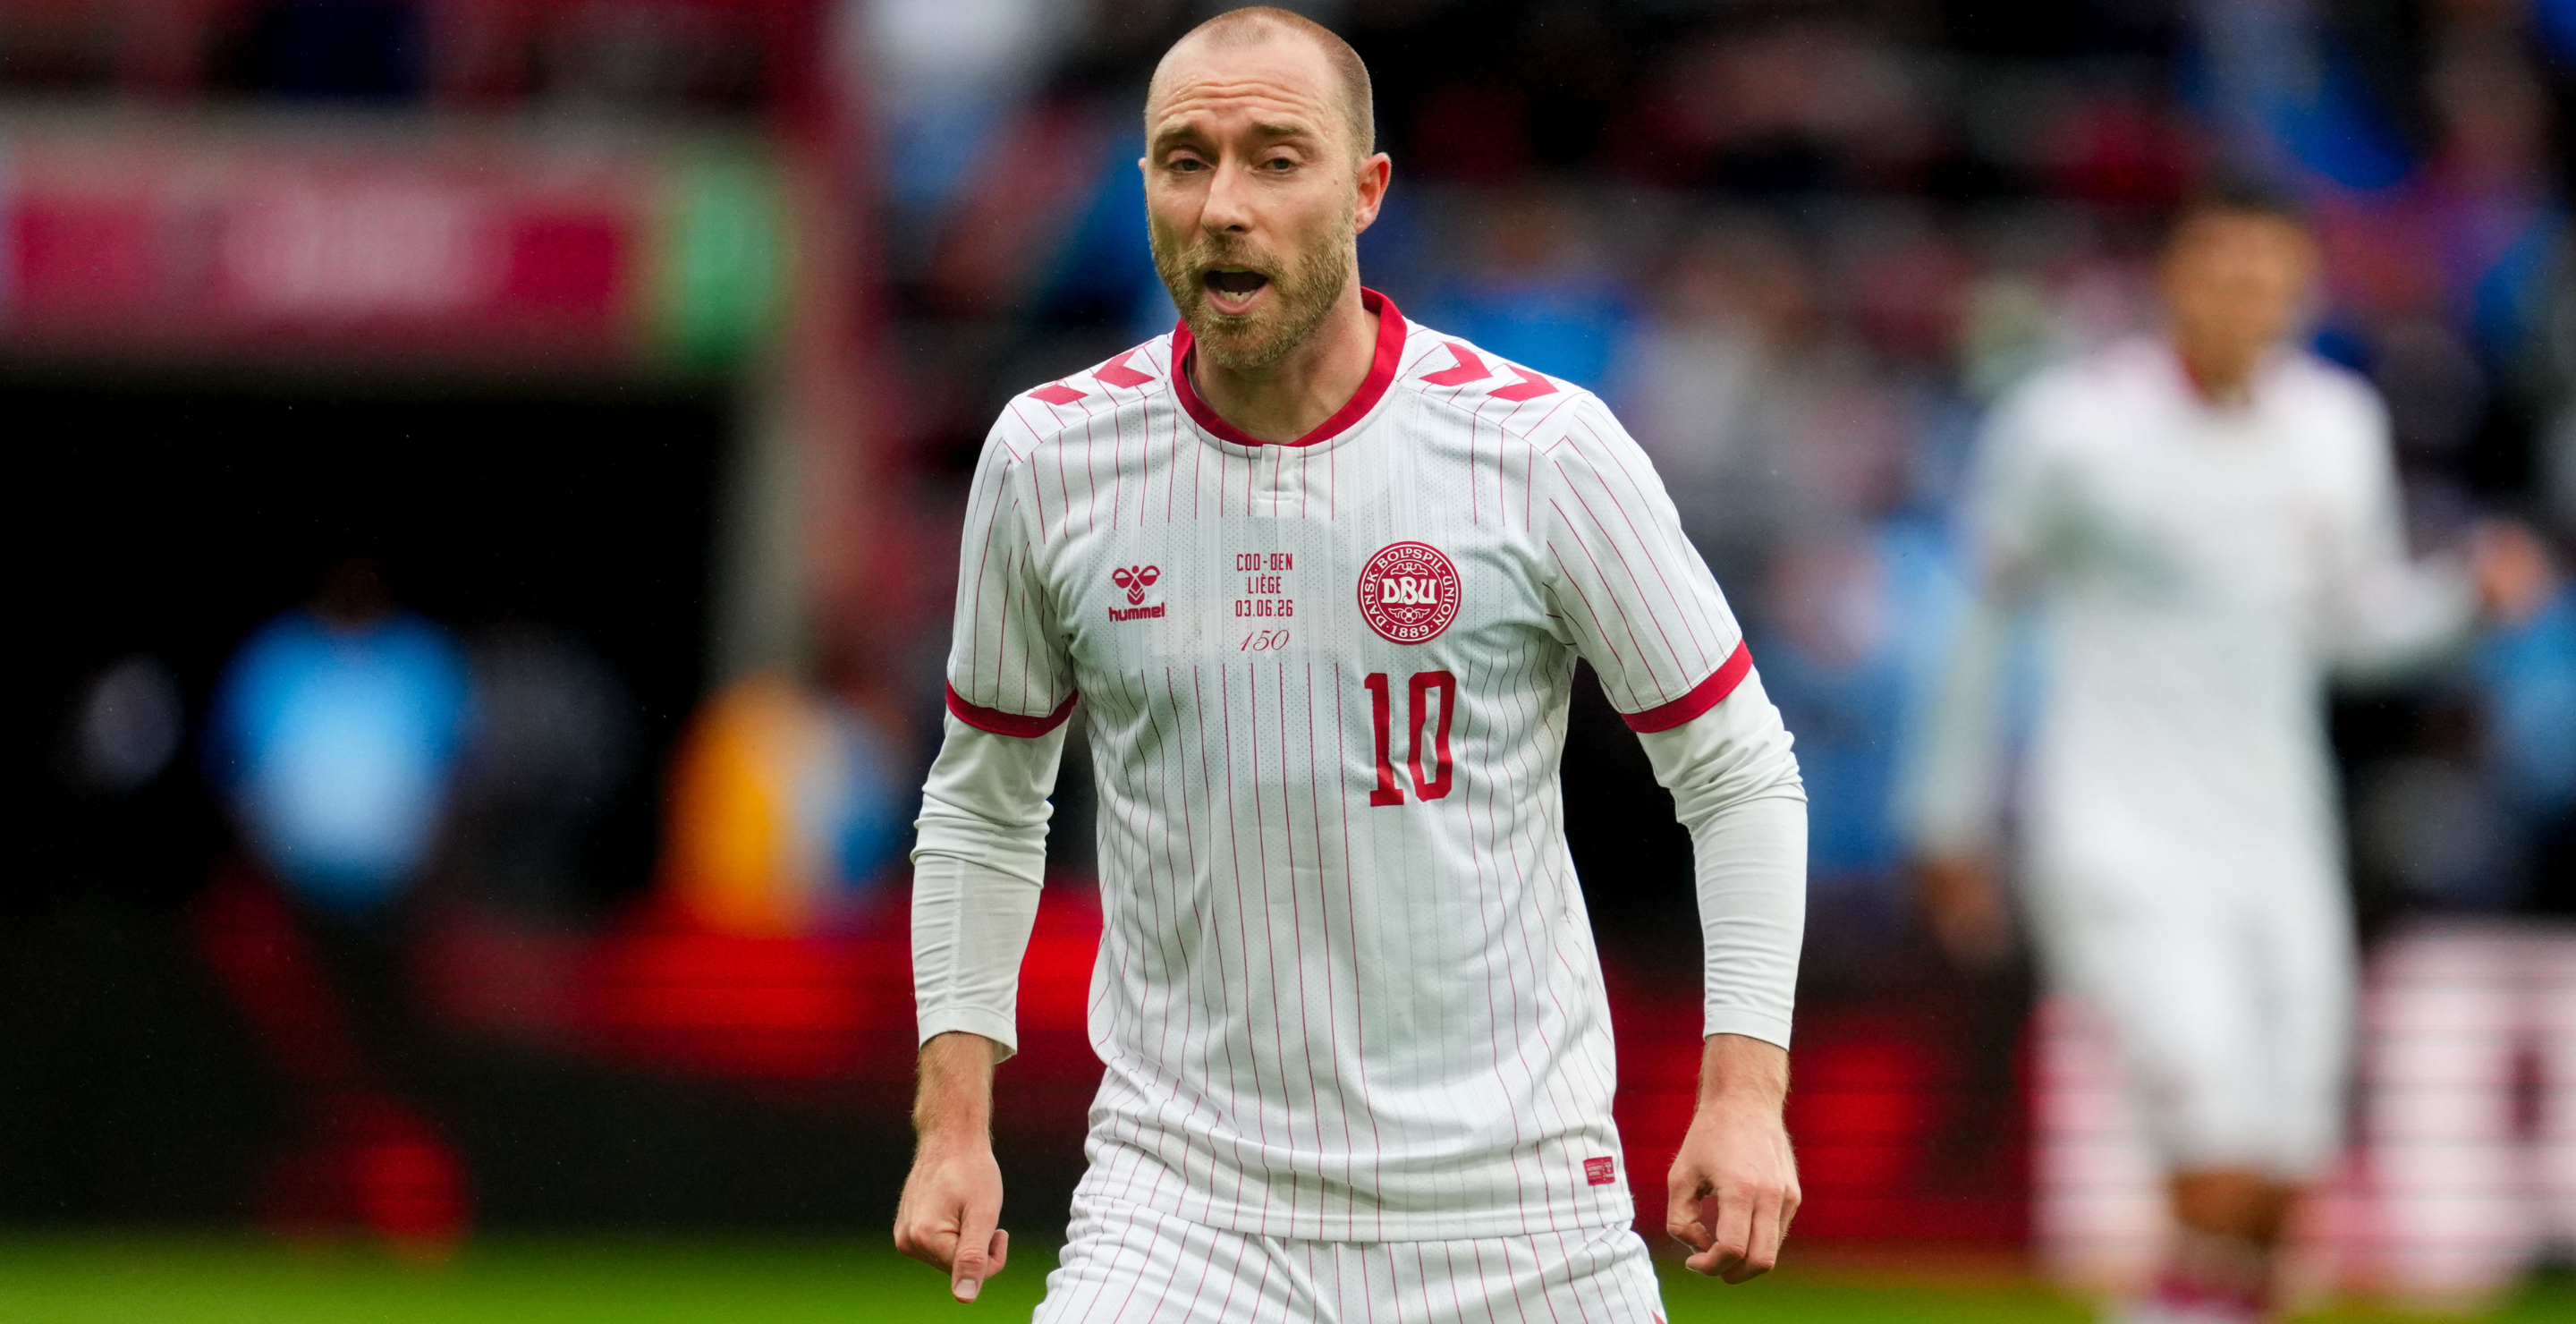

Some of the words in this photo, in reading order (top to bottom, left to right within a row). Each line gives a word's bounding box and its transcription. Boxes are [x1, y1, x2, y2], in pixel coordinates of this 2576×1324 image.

[1236, 553, 1293, 571] COD-DEN
[1248, 573, 1282, 594] LIÈGE
[1381, 576, 1437, 605] DBU
[1235, 599, 1293, 617] 03.06.26
[1364, 571, 1387, 627] DANSK
[1108, 601, 1165, 623] hummel
[1240, 629, 1291, 651] 150
[1390, 625, 1429, 638] 1889
[1364, 671, 1456, 807] 10
